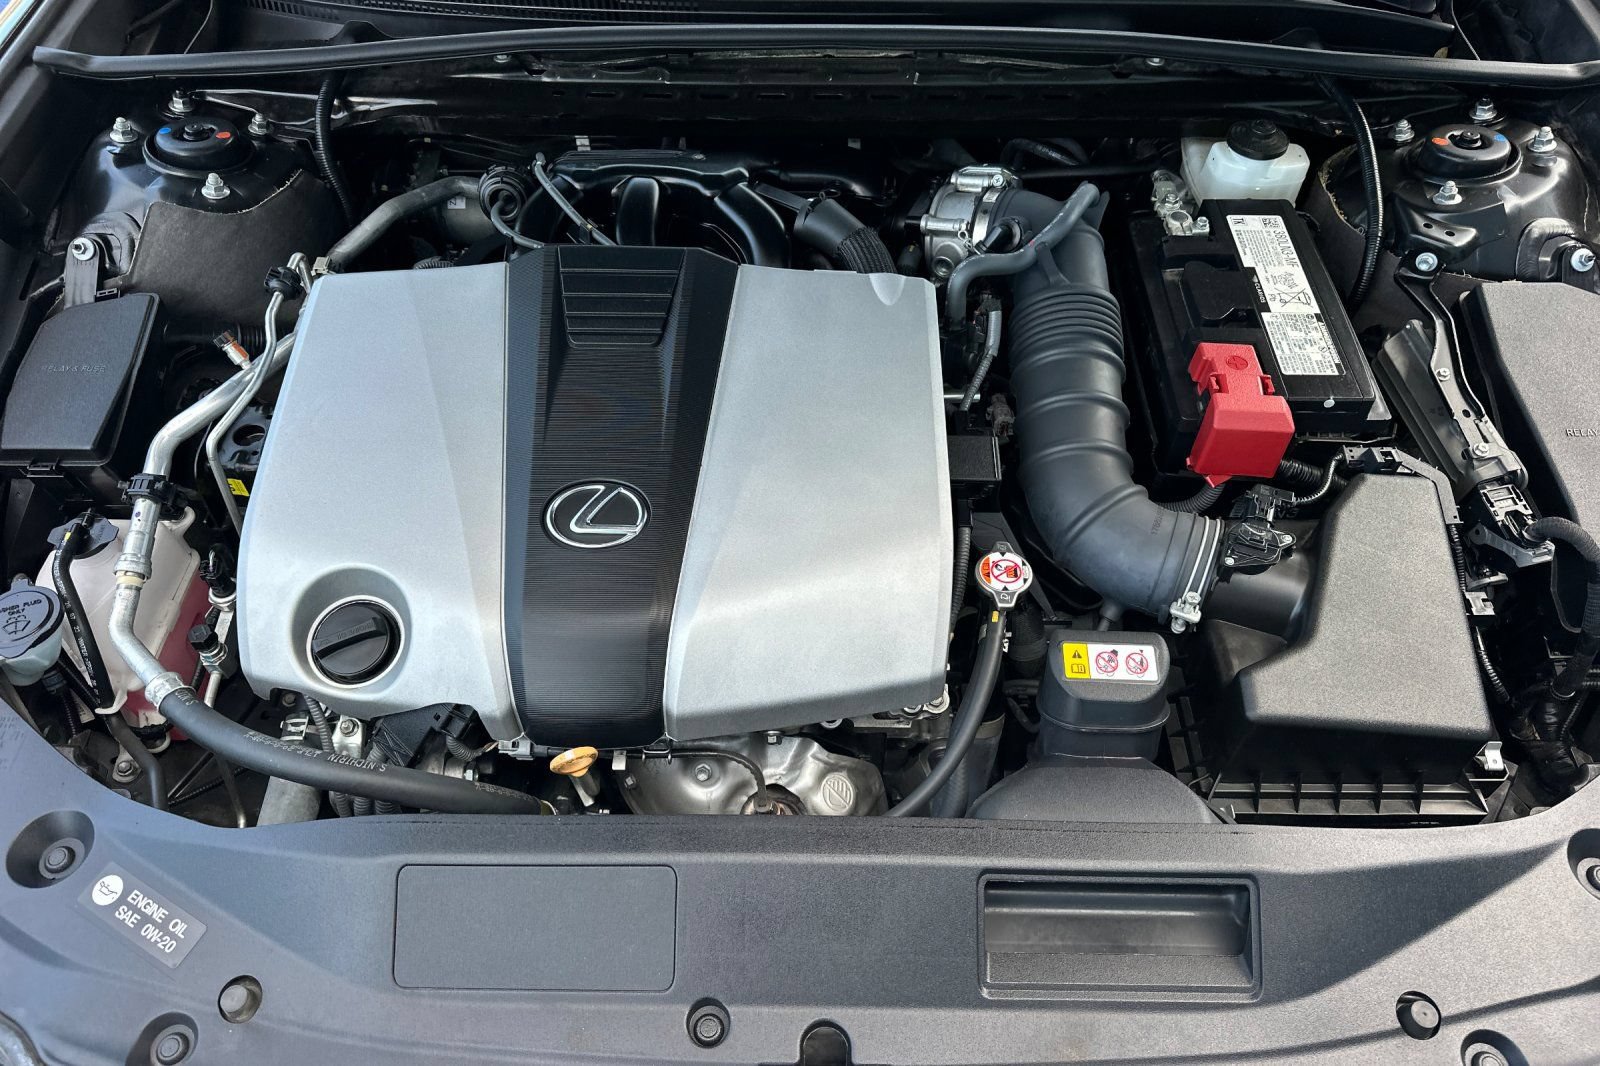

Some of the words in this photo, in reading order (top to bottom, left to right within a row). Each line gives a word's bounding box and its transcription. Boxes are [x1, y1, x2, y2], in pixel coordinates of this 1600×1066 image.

[114, 905, 141, 929] SAE
[140, 923, 177, 954] 0W-20
[126, 889, 169, 924] ENGINE
[168, 918, 188, 939] OIL
